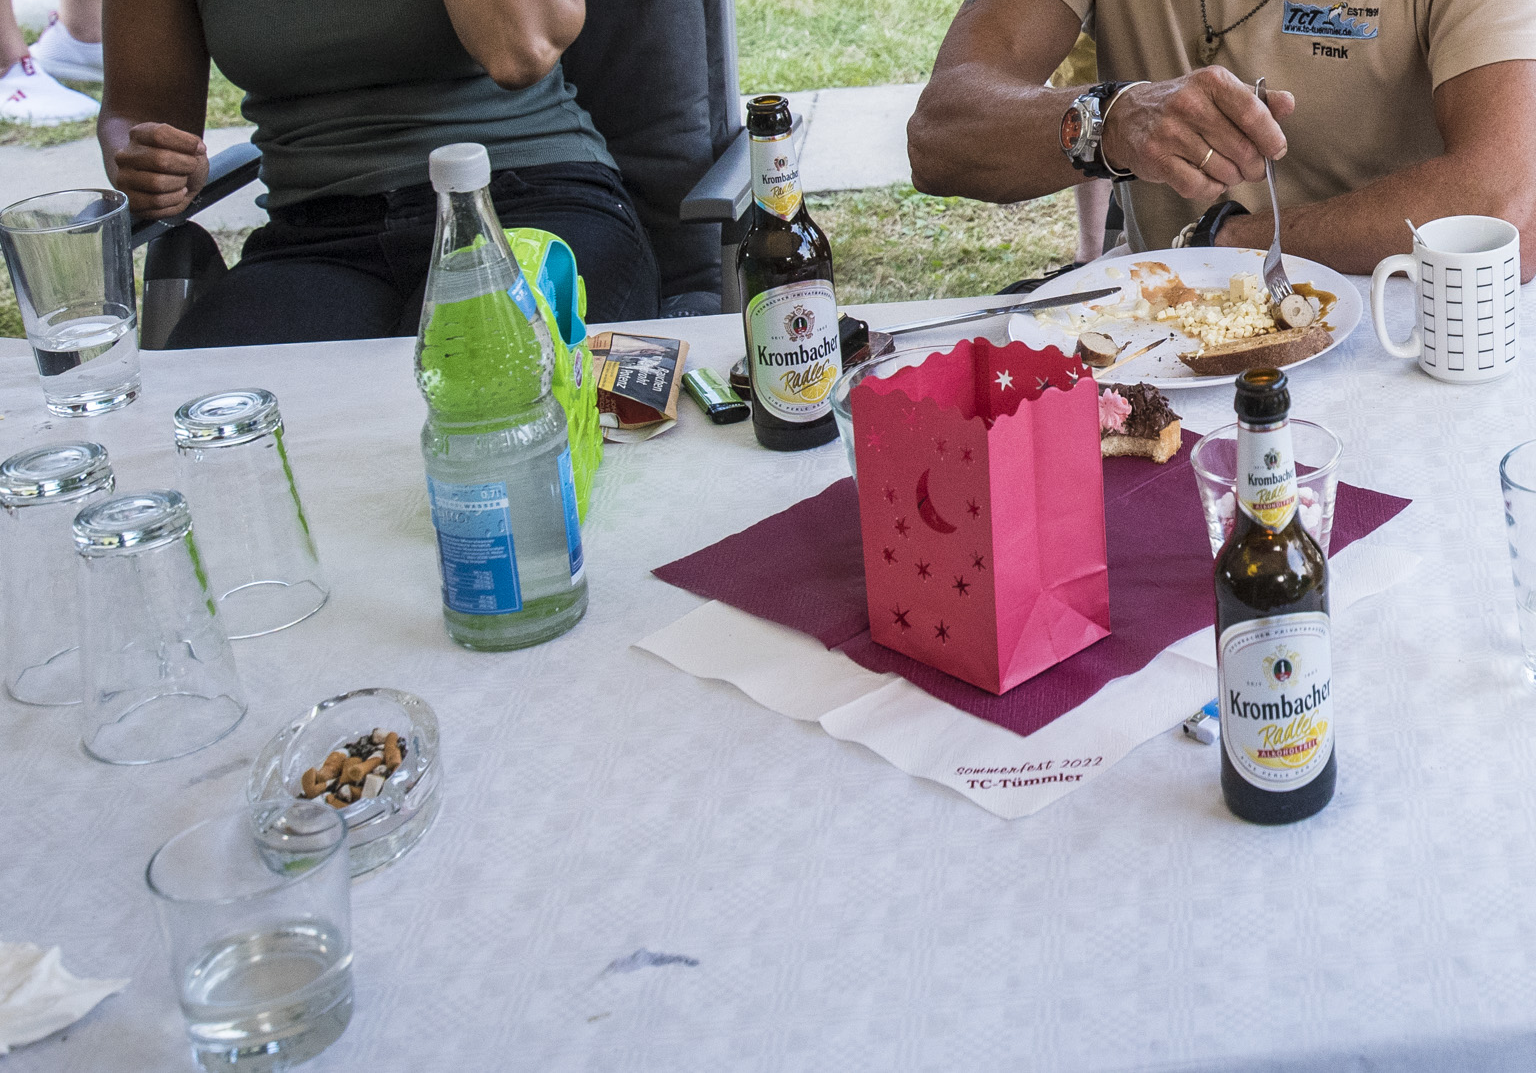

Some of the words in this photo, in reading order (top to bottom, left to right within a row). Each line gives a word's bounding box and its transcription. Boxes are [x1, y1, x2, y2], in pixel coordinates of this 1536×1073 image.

[1347, 7, 1364, 17] EST
[1312, 42, 1349, 59] Frank
[761, 169, 799, 185] Krombacher
[757, 333, 838, 367] Krombacher
[779, 358, 830, 395] Radler
[1229, 678, 1332, 723] Krombacher
[1257, 709, 1320, 751] Radler
[1260, 738, 1317, 758] ALKOHOLFREI
[1060, 755, 1104, 769] 2022
[966, 772, 1084, 790] TC-Tümmler
